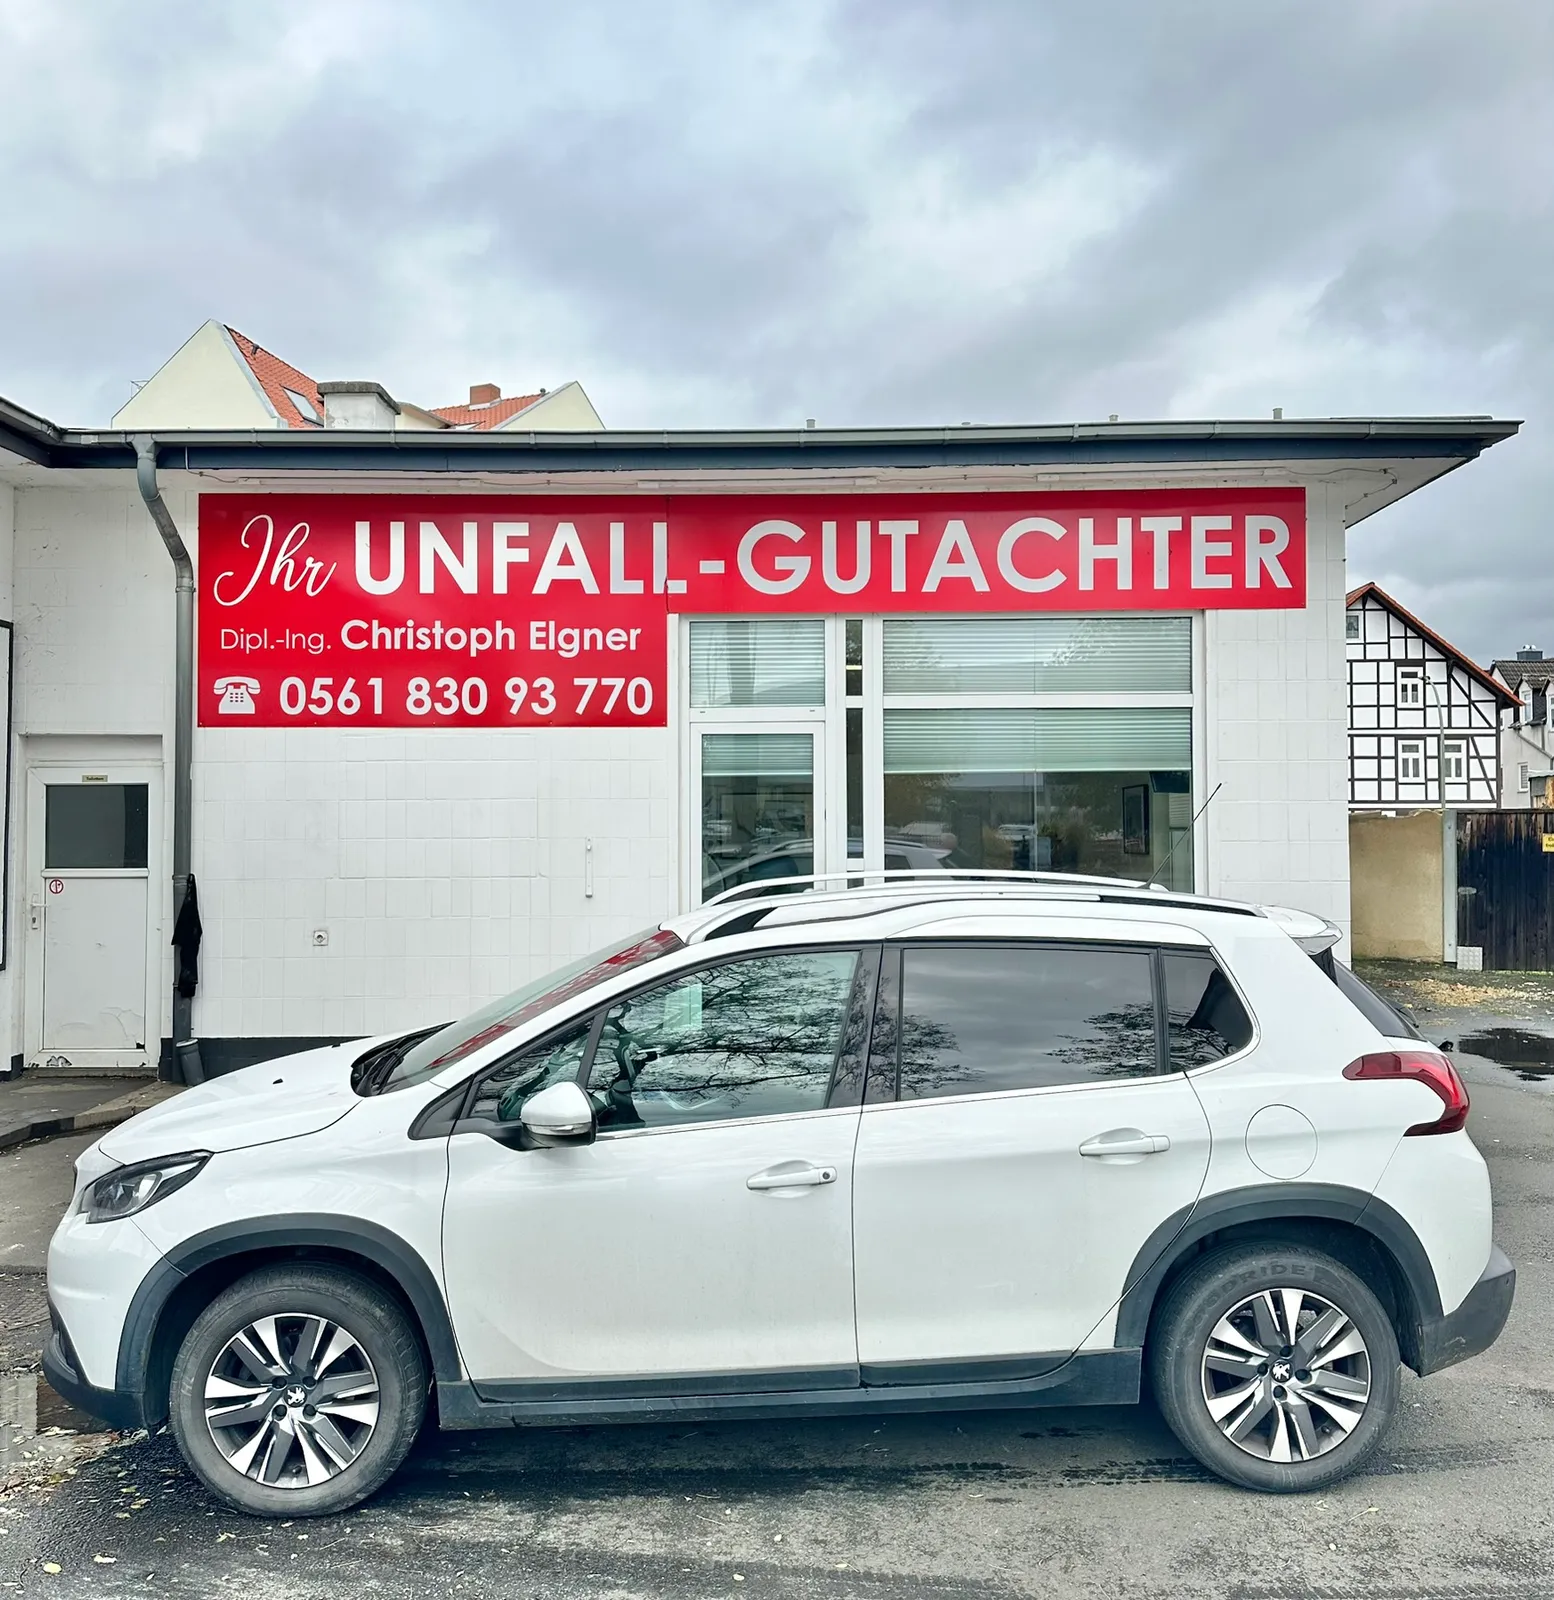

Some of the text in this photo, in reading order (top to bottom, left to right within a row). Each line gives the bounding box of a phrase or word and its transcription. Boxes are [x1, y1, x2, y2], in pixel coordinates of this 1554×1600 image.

[213, 514, 338, 607] Ihr
[221, 619, 642, 659] Dipl.-Ing. Christoph Elgner
[279, 676, 653, 716] 0561 830 93 770
